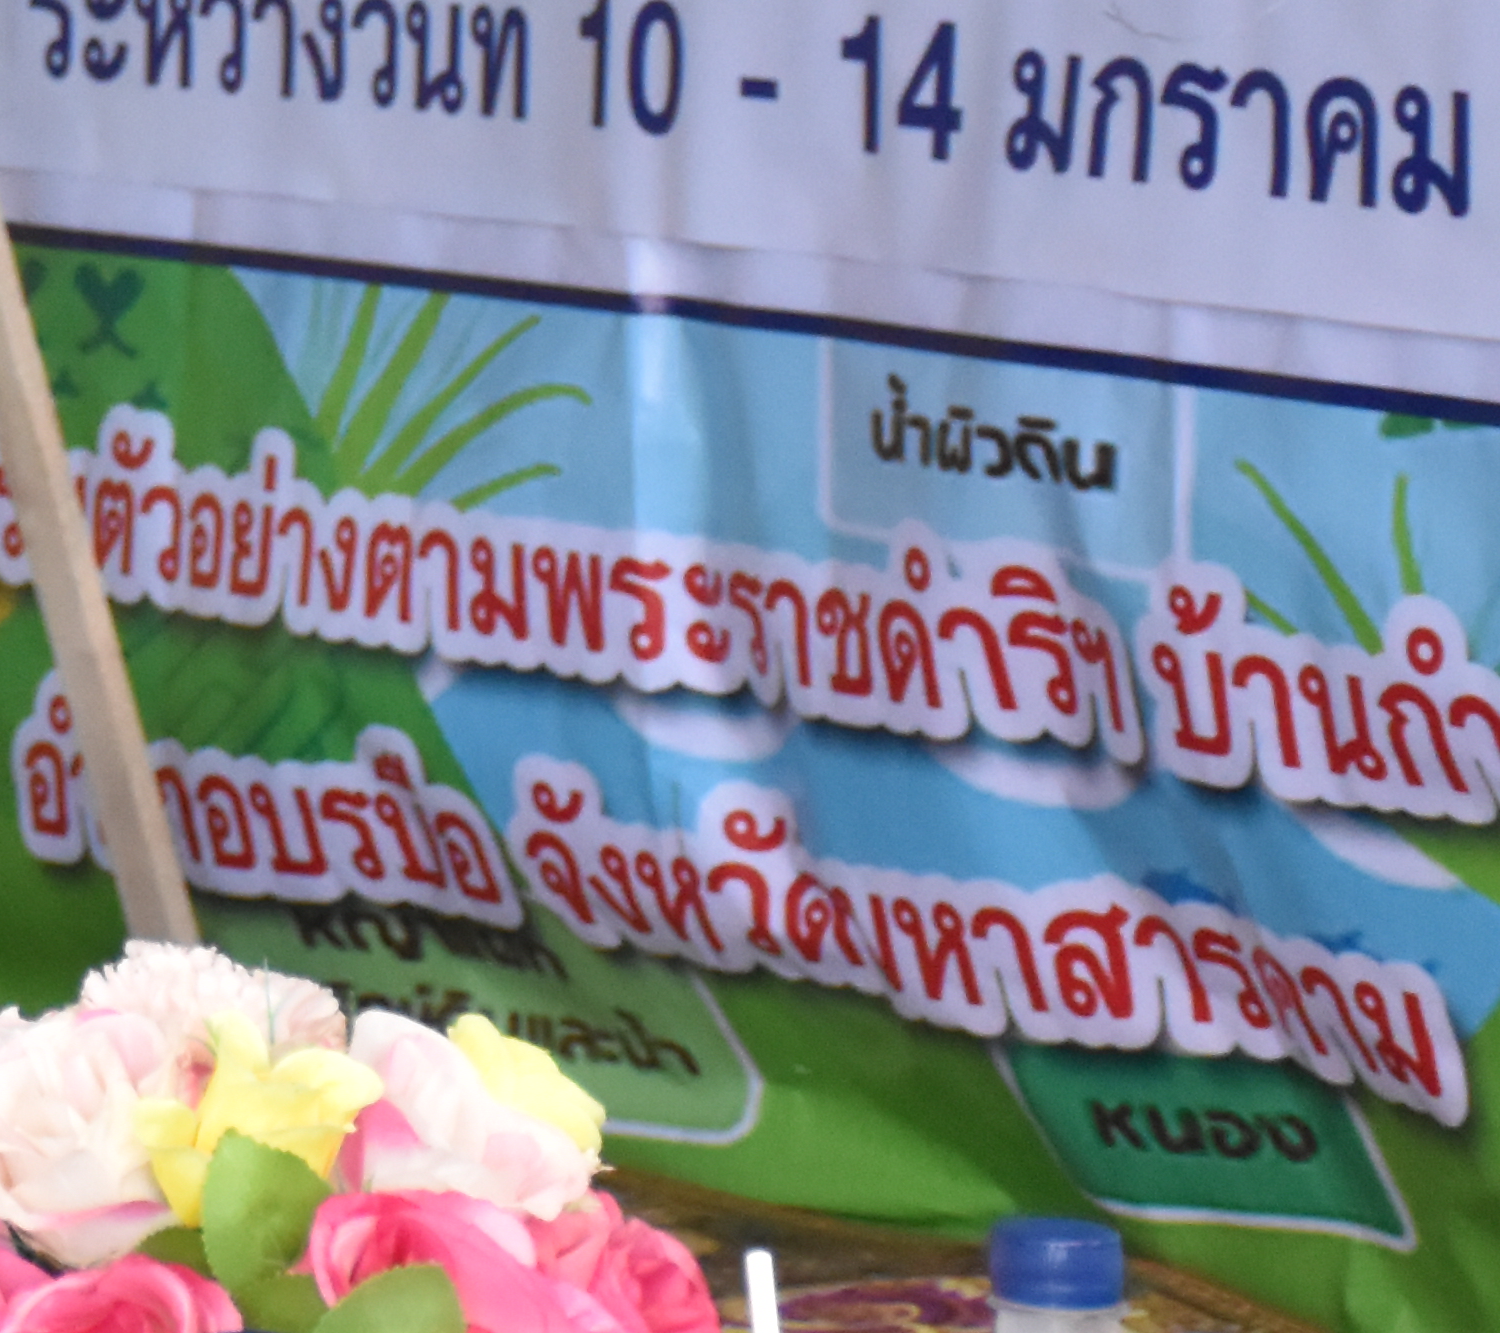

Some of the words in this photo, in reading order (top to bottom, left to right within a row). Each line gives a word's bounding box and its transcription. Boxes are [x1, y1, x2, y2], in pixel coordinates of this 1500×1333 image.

[739, 75, 780, 102] -
[840, 13, 964, 163] 14
[1004, 47, 1473, 219] มกราคม
[871, 376, 1116, 492] น้ำผิวดิน
[524, 780, 1441, 1101] จังหวัดมหาสารคาม
[1086, 1097, 1317, 1163] หนอง
